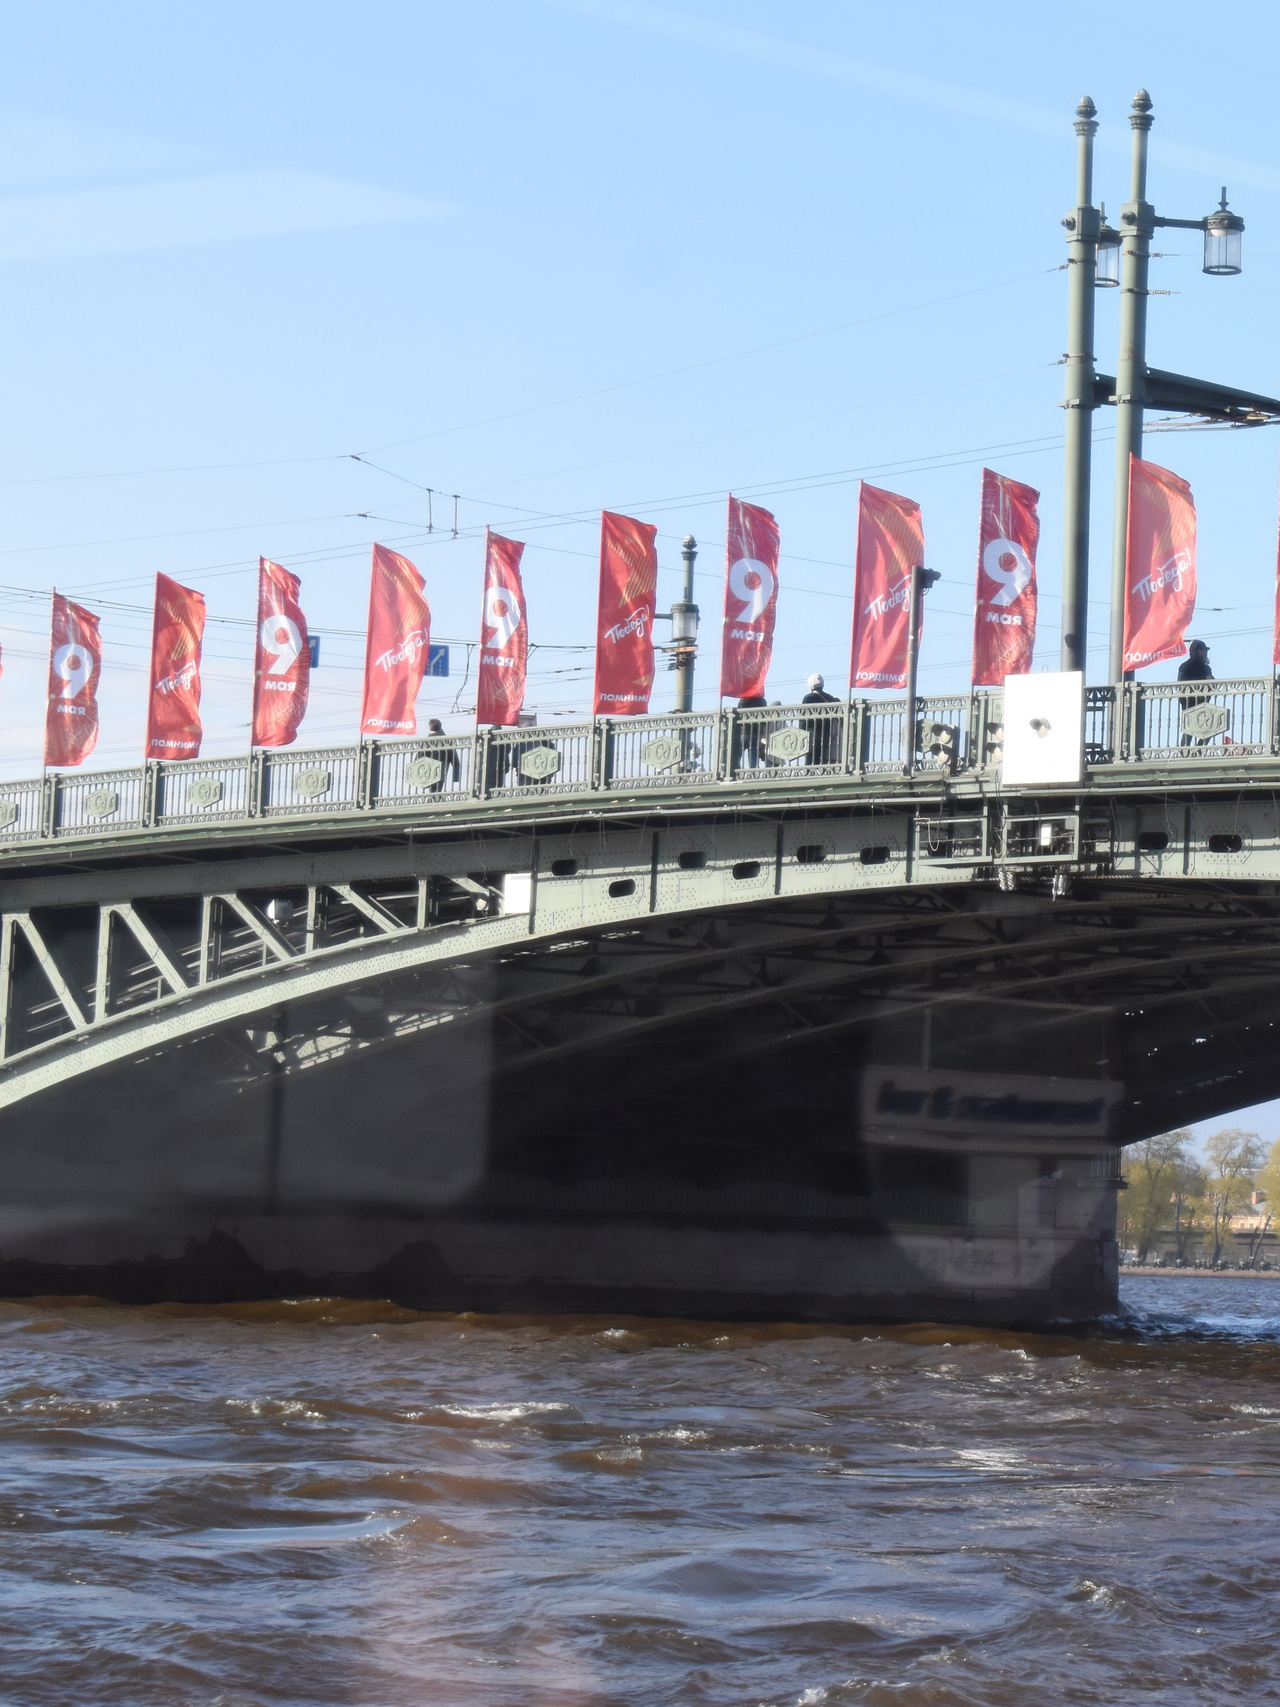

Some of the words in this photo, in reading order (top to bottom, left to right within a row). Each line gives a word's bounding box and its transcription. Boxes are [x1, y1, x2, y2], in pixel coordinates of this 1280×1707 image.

[729, 558, 774, 624] 9
[864, 574, 912, 620] Побед
[983, 537, 1032, 606] 9
[1131, 547, 1192, 602] Победа!
[261, 615, 303, 675] 9
[485, 586, 521, 650] 9
[54, 643, 94, 699] 9
